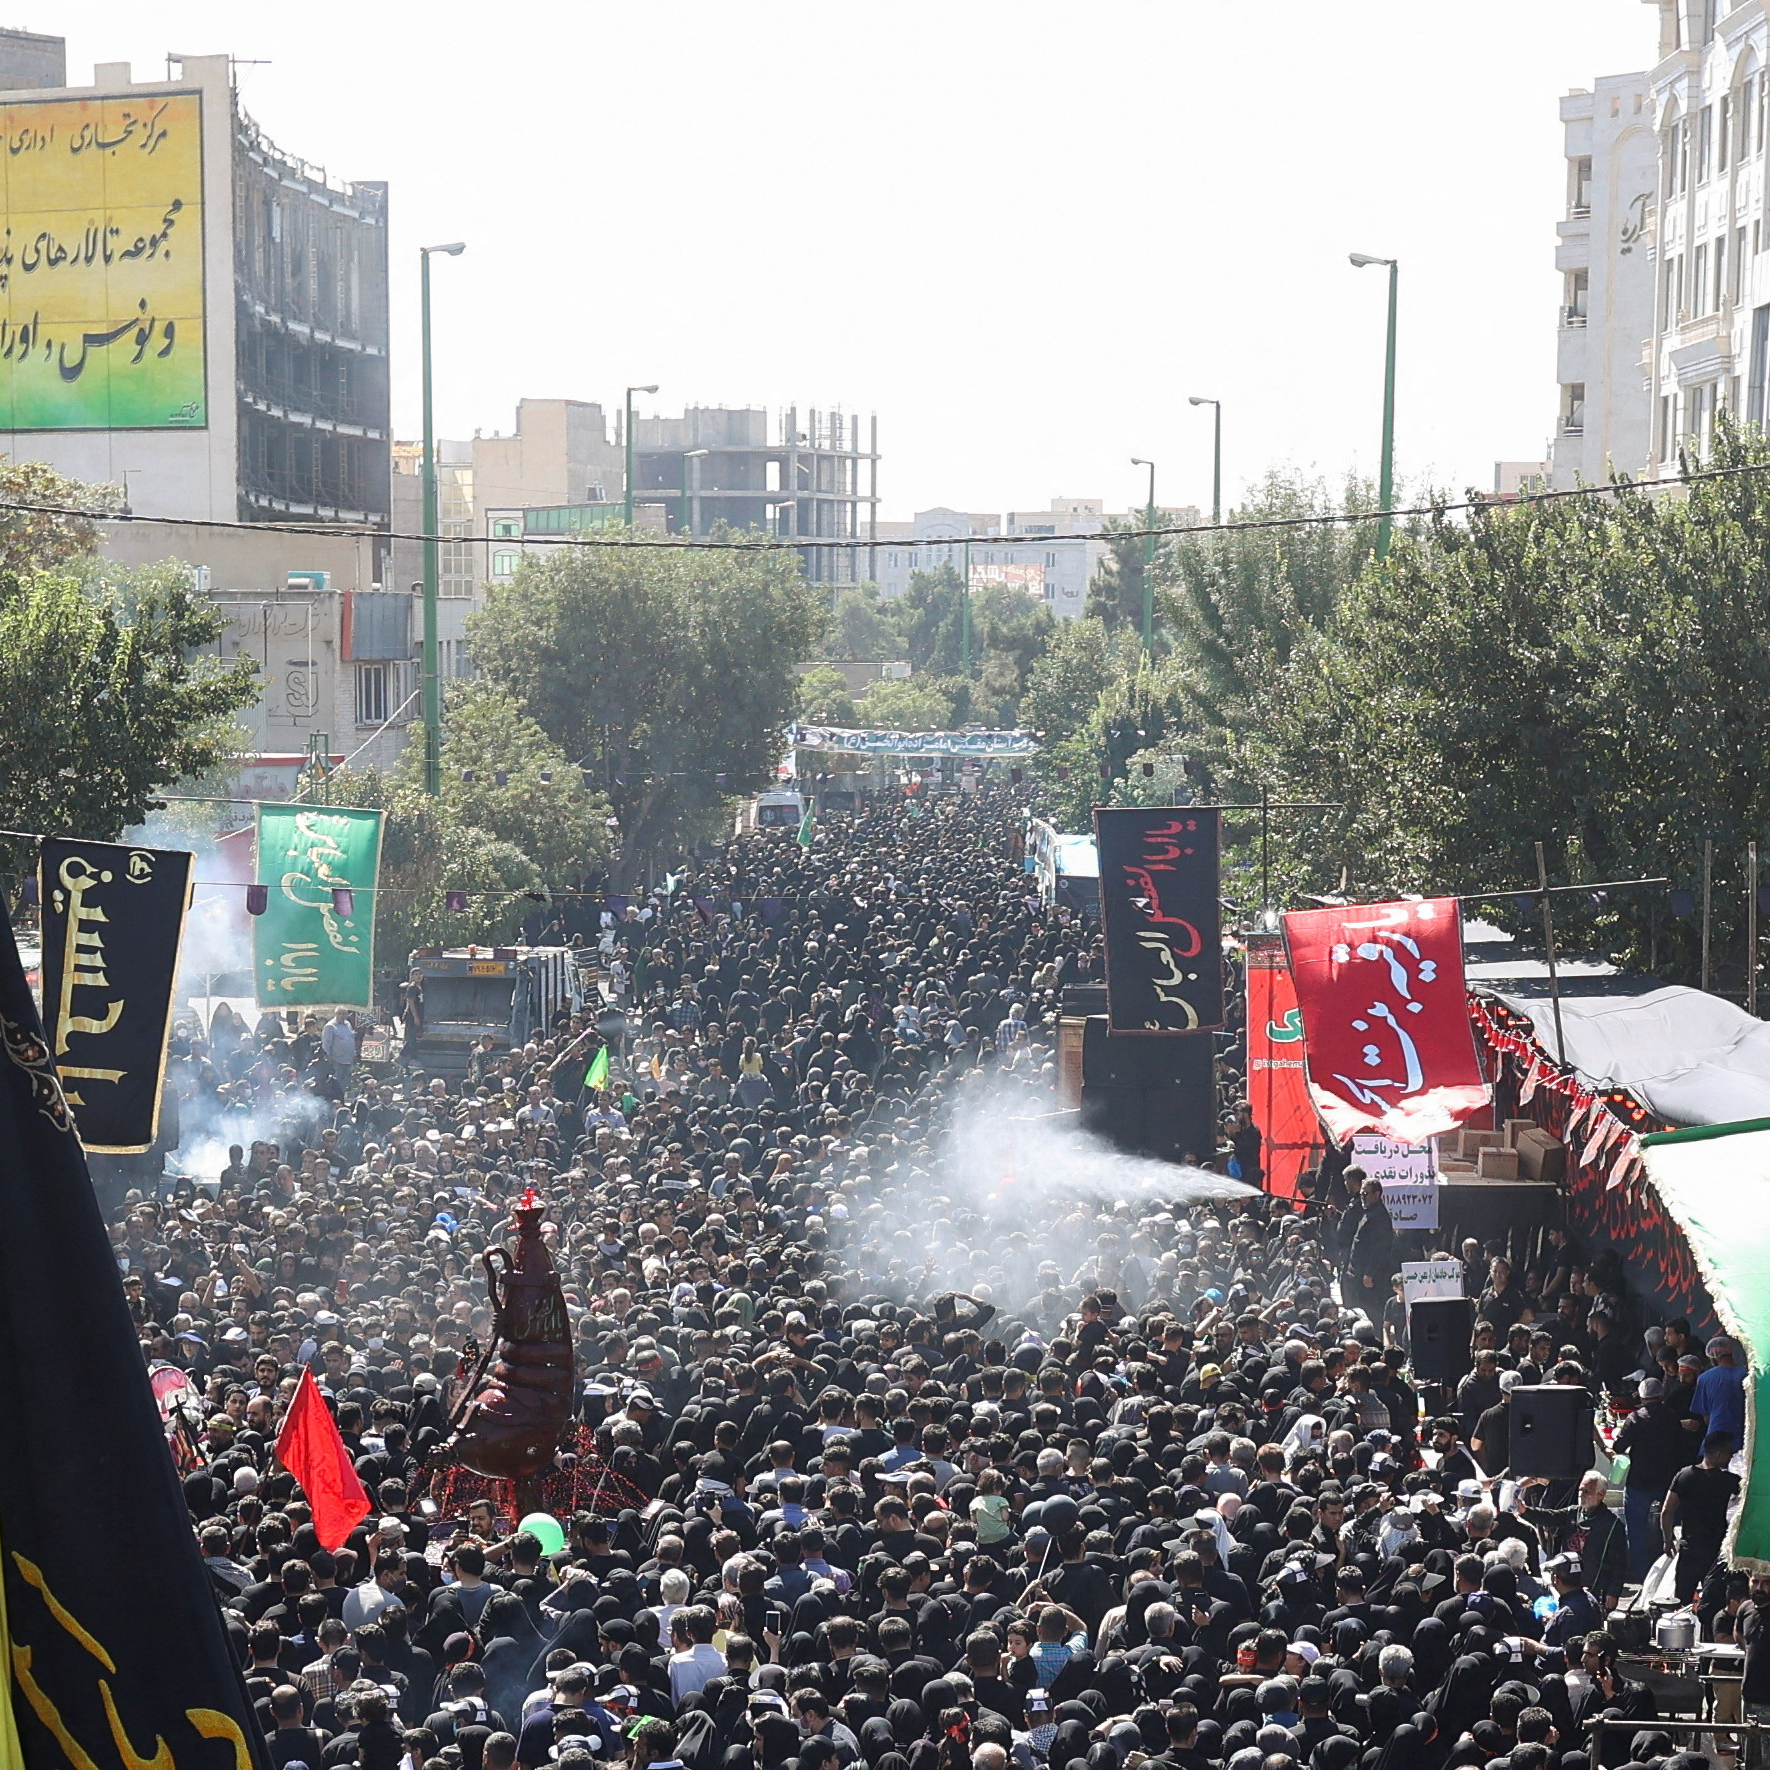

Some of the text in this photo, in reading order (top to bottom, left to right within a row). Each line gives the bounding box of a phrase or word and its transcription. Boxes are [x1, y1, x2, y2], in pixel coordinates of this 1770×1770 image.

[9, 126, 55, 155] اداری
[70, 119, 138, 157] تجاری
[139, 101, 168, 155] مرکز
[119, 199, 183, 261] مجموعه
[60, 298, 177, 382] ونوس
[44, 856, 125, 1056] حسین
[1329, 930, 1439, 1001] رقیه
[1354, 1140, 1400, 1160] دریافت
[1398, 1165, 1436, 1184] نذورات
